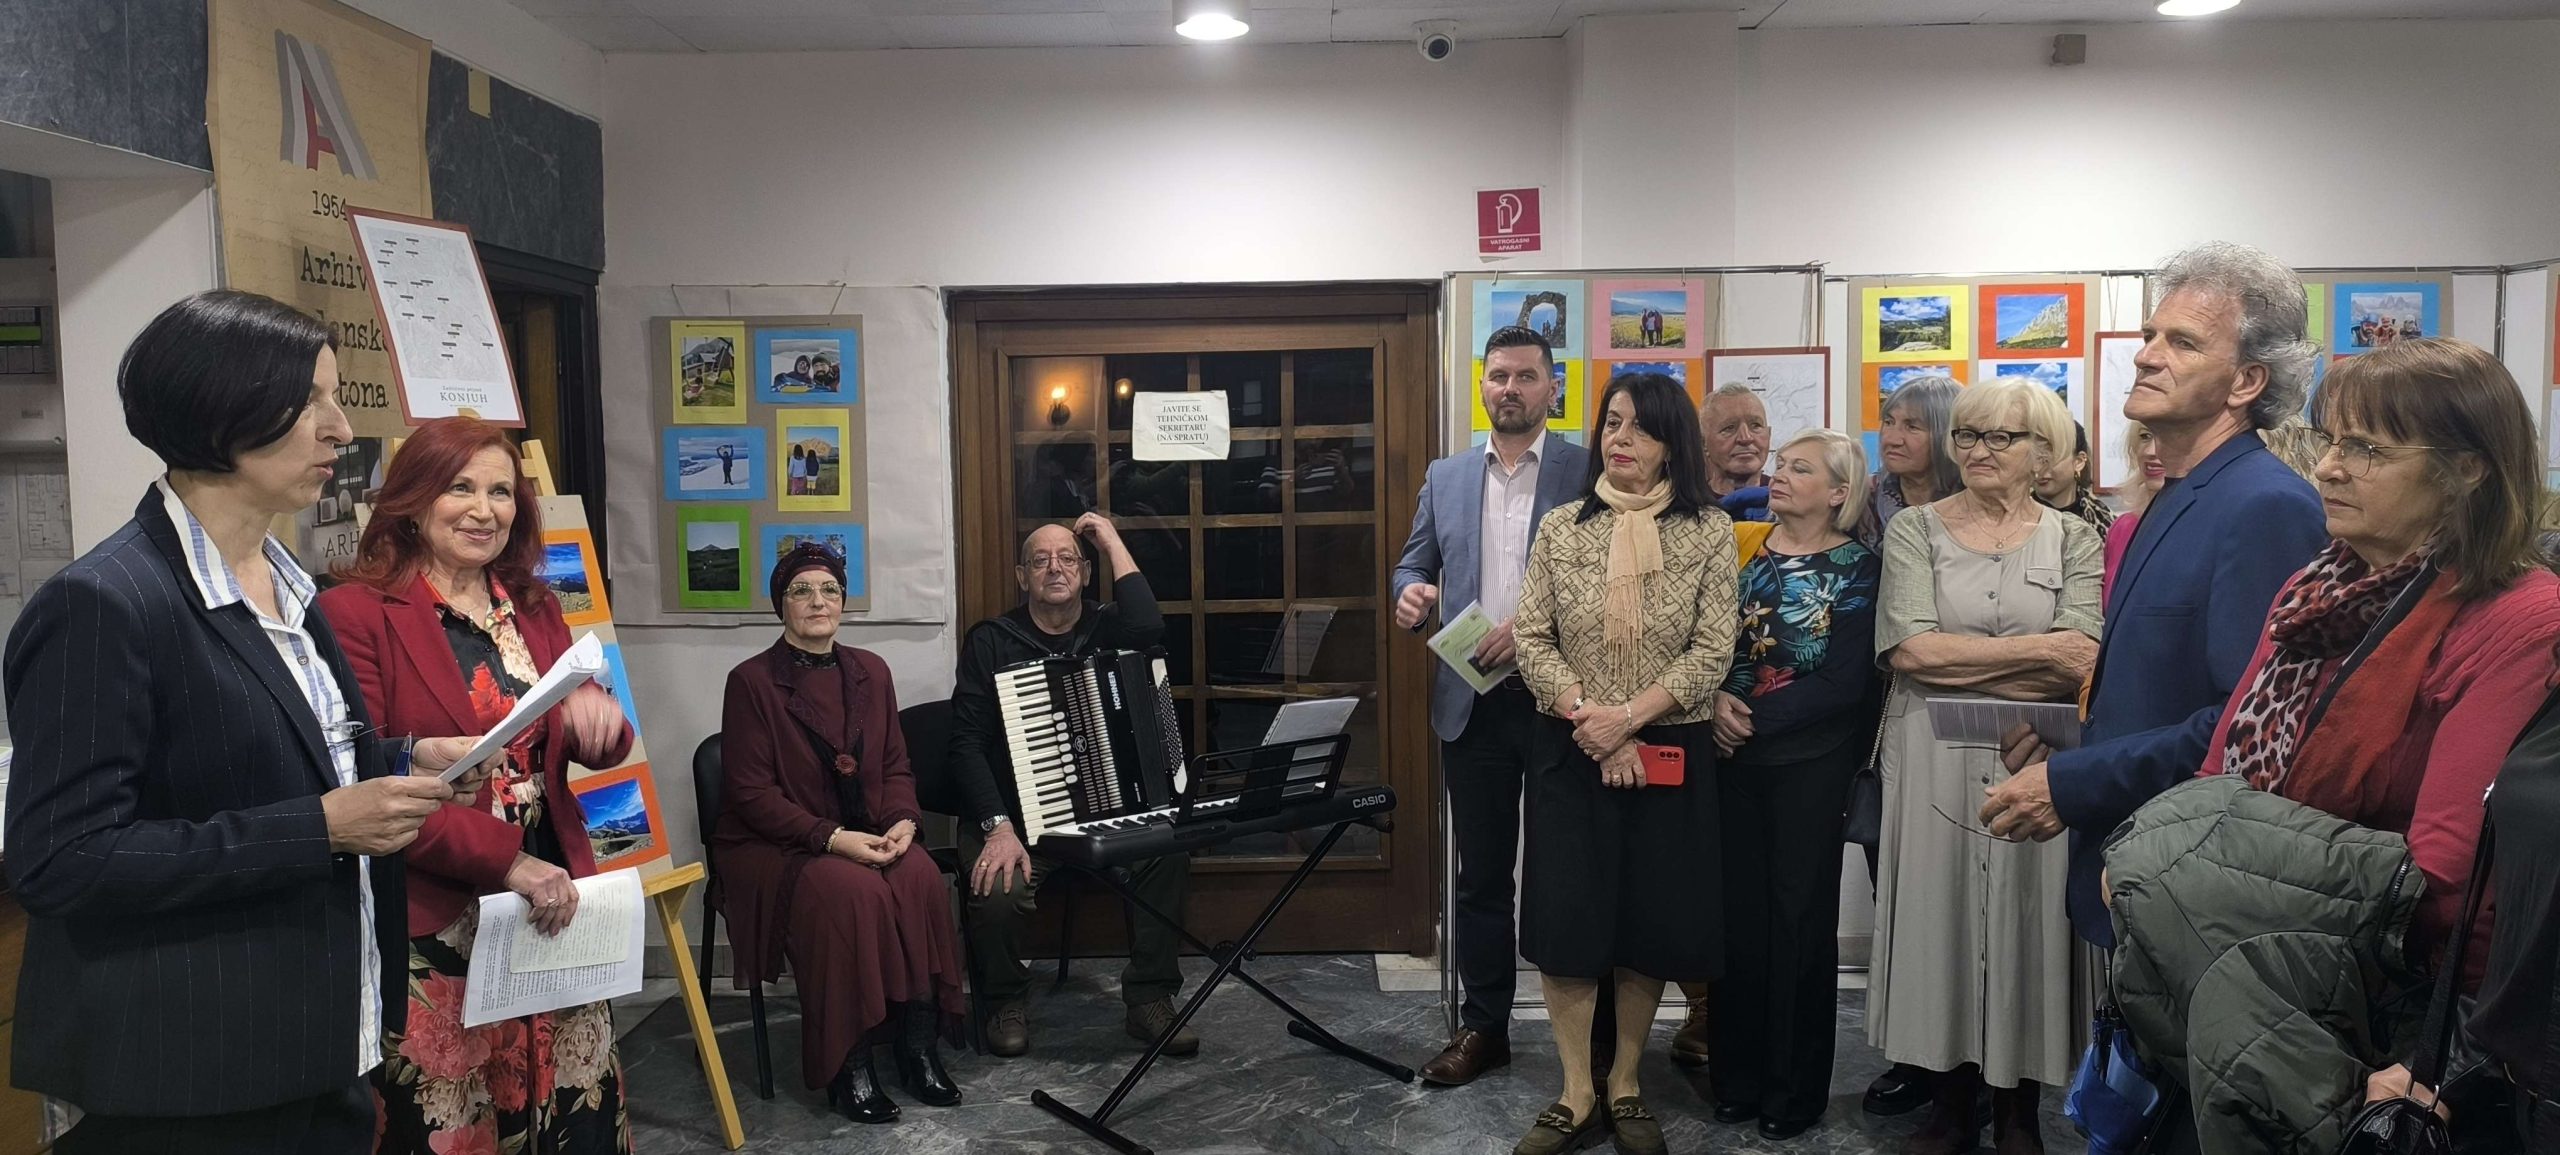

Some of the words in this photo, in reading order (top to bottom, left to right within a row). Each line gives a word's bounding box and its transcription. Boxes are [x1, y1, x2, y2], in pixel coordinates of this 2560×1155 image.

[1490, 237, 1530, 245] VATROGASNI
[301, 246, 367, 291] Arhiv
[440, 391, 488, 403] KONJUH
[1162, 405, 1190, 413] JAVITE
[1192, 404, 1202, 412] SE
[1156, 413, 1208, 422] TEHNIČKOM
[1158, 423, 1207, 432] SEKRETARU
[1157, 433, 1173, 442] (NA
[1174, 433, 1209, 441] SPRATU)
[1107, 671, 1121, 710] HOHNER
[1352, 794, 1387, 809] CASIO
